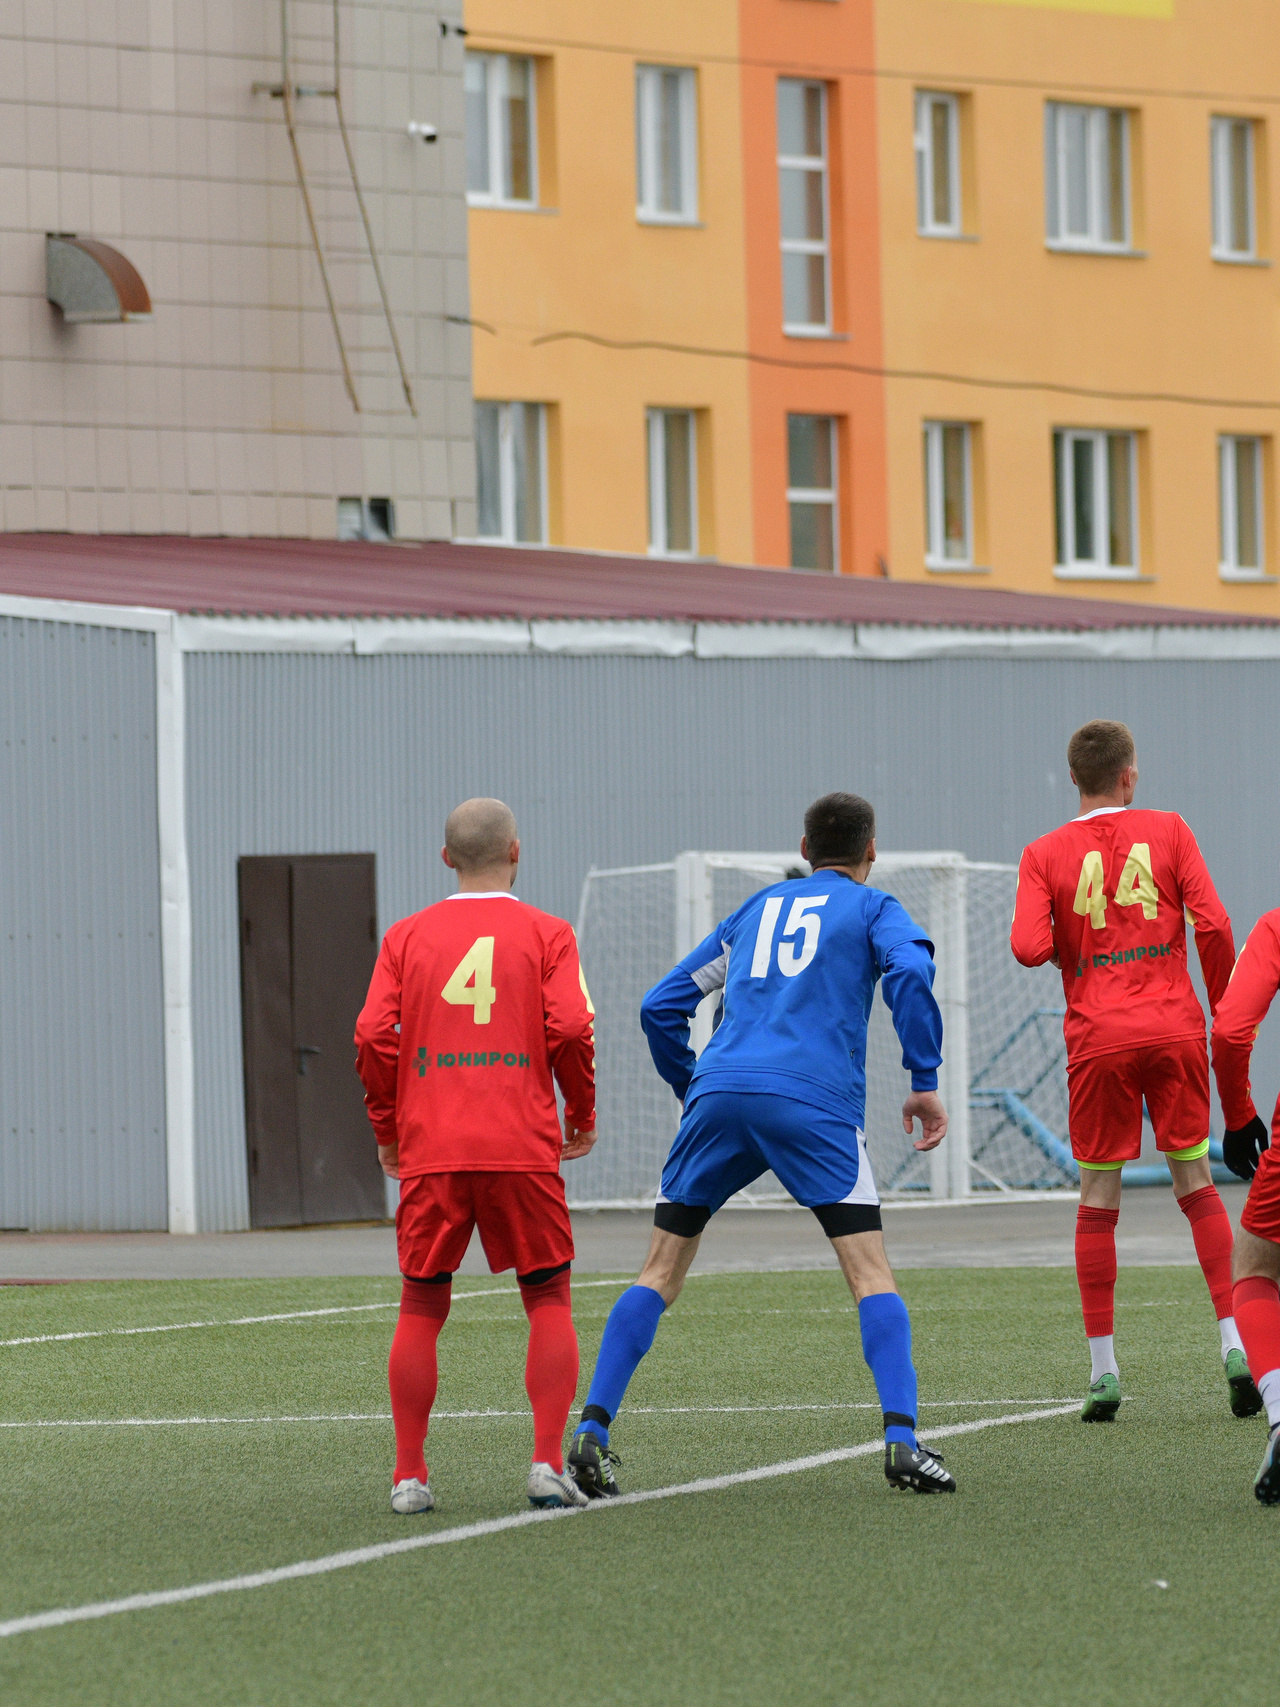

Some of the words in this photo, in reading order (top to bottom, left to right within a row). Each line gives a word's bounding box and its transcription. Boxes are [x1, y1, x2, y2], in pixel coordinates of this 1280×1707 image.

[1073, 843, 1159, 930] 44
[750, 894, 830, 978] 15
[1092, 943, 1171, 968] ЮНИРОН
[441, 936, 496, 1025] 4
[437, 1052, 530, 1068] ЮНИРОН
